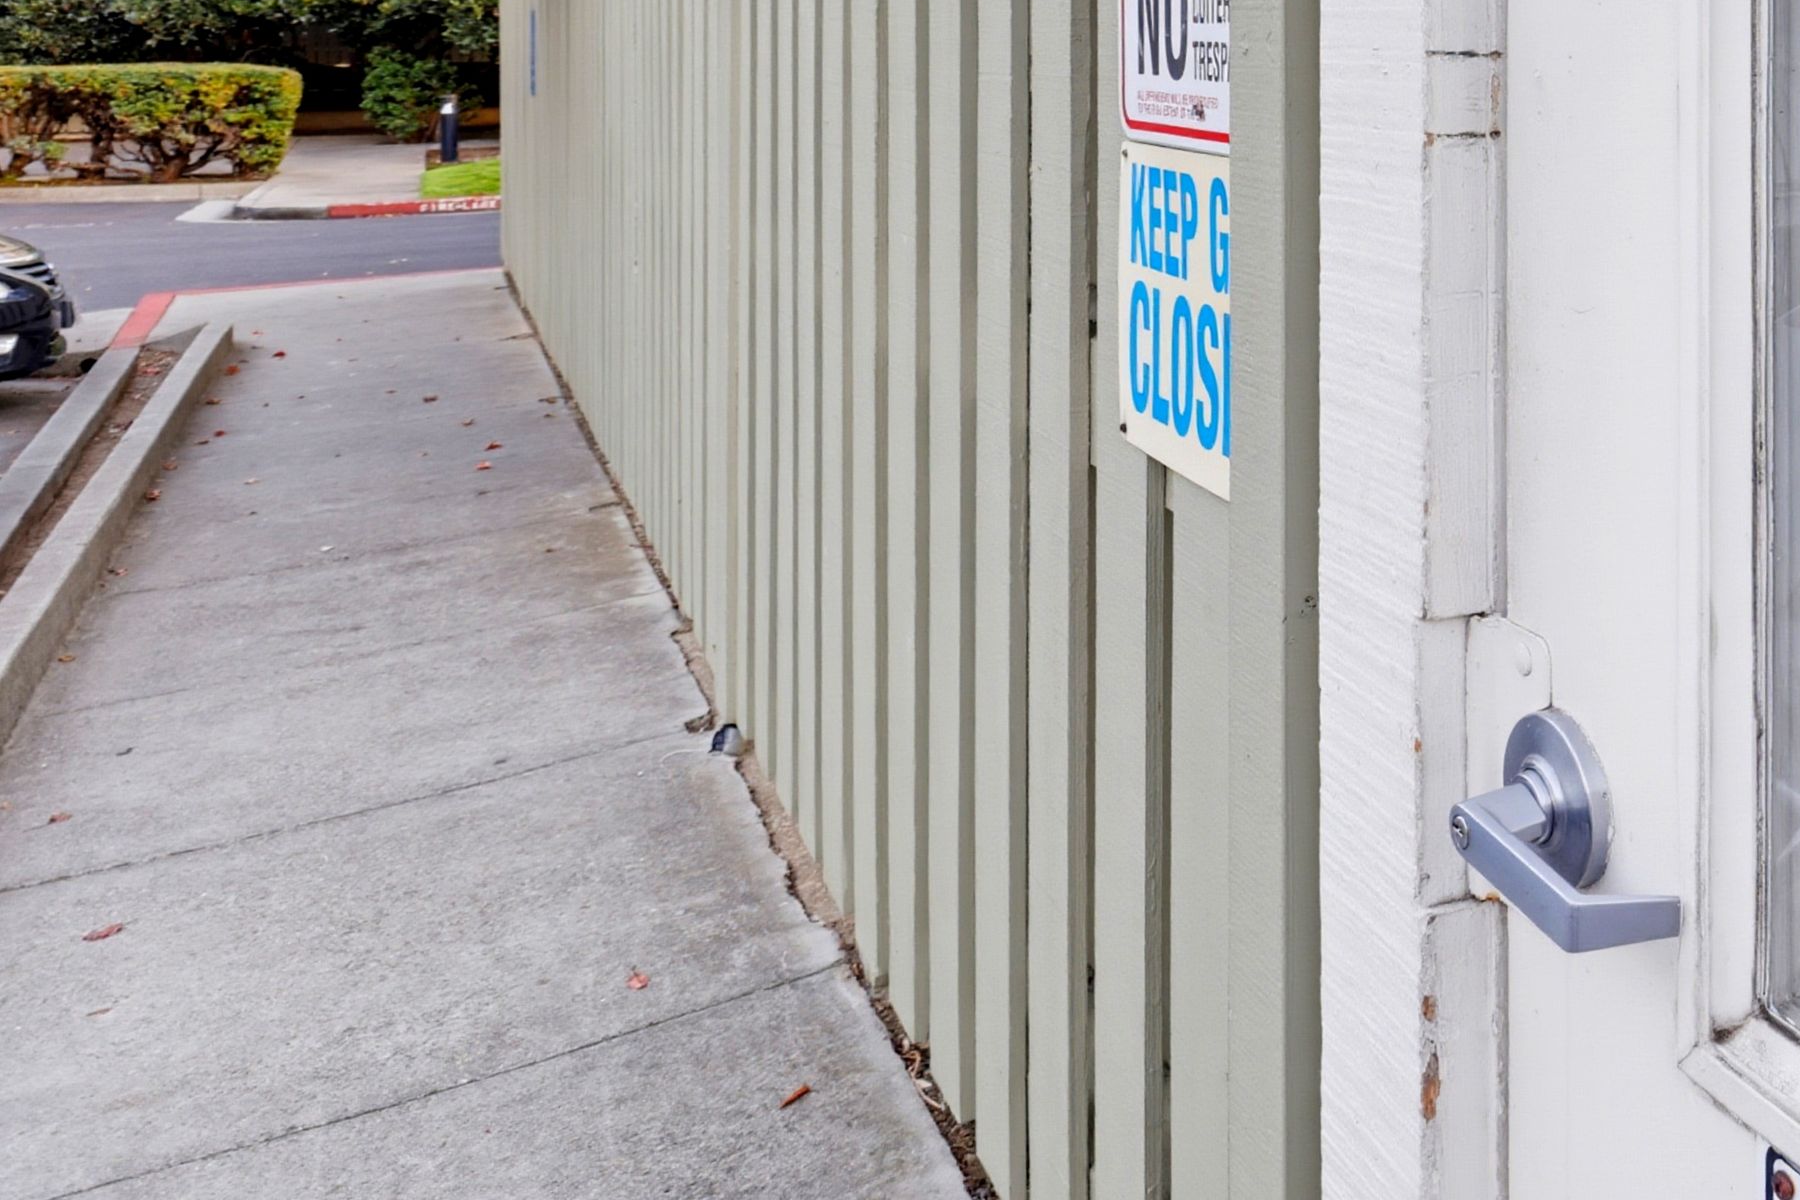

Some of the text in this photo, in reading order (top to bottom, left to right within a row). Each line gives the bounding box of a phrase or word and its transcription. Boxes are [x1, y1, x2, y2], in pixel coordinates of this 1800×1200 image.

[1192, 41, 1230, 82] TRESP
[1131, 162, 1229, 294] KEEP G
